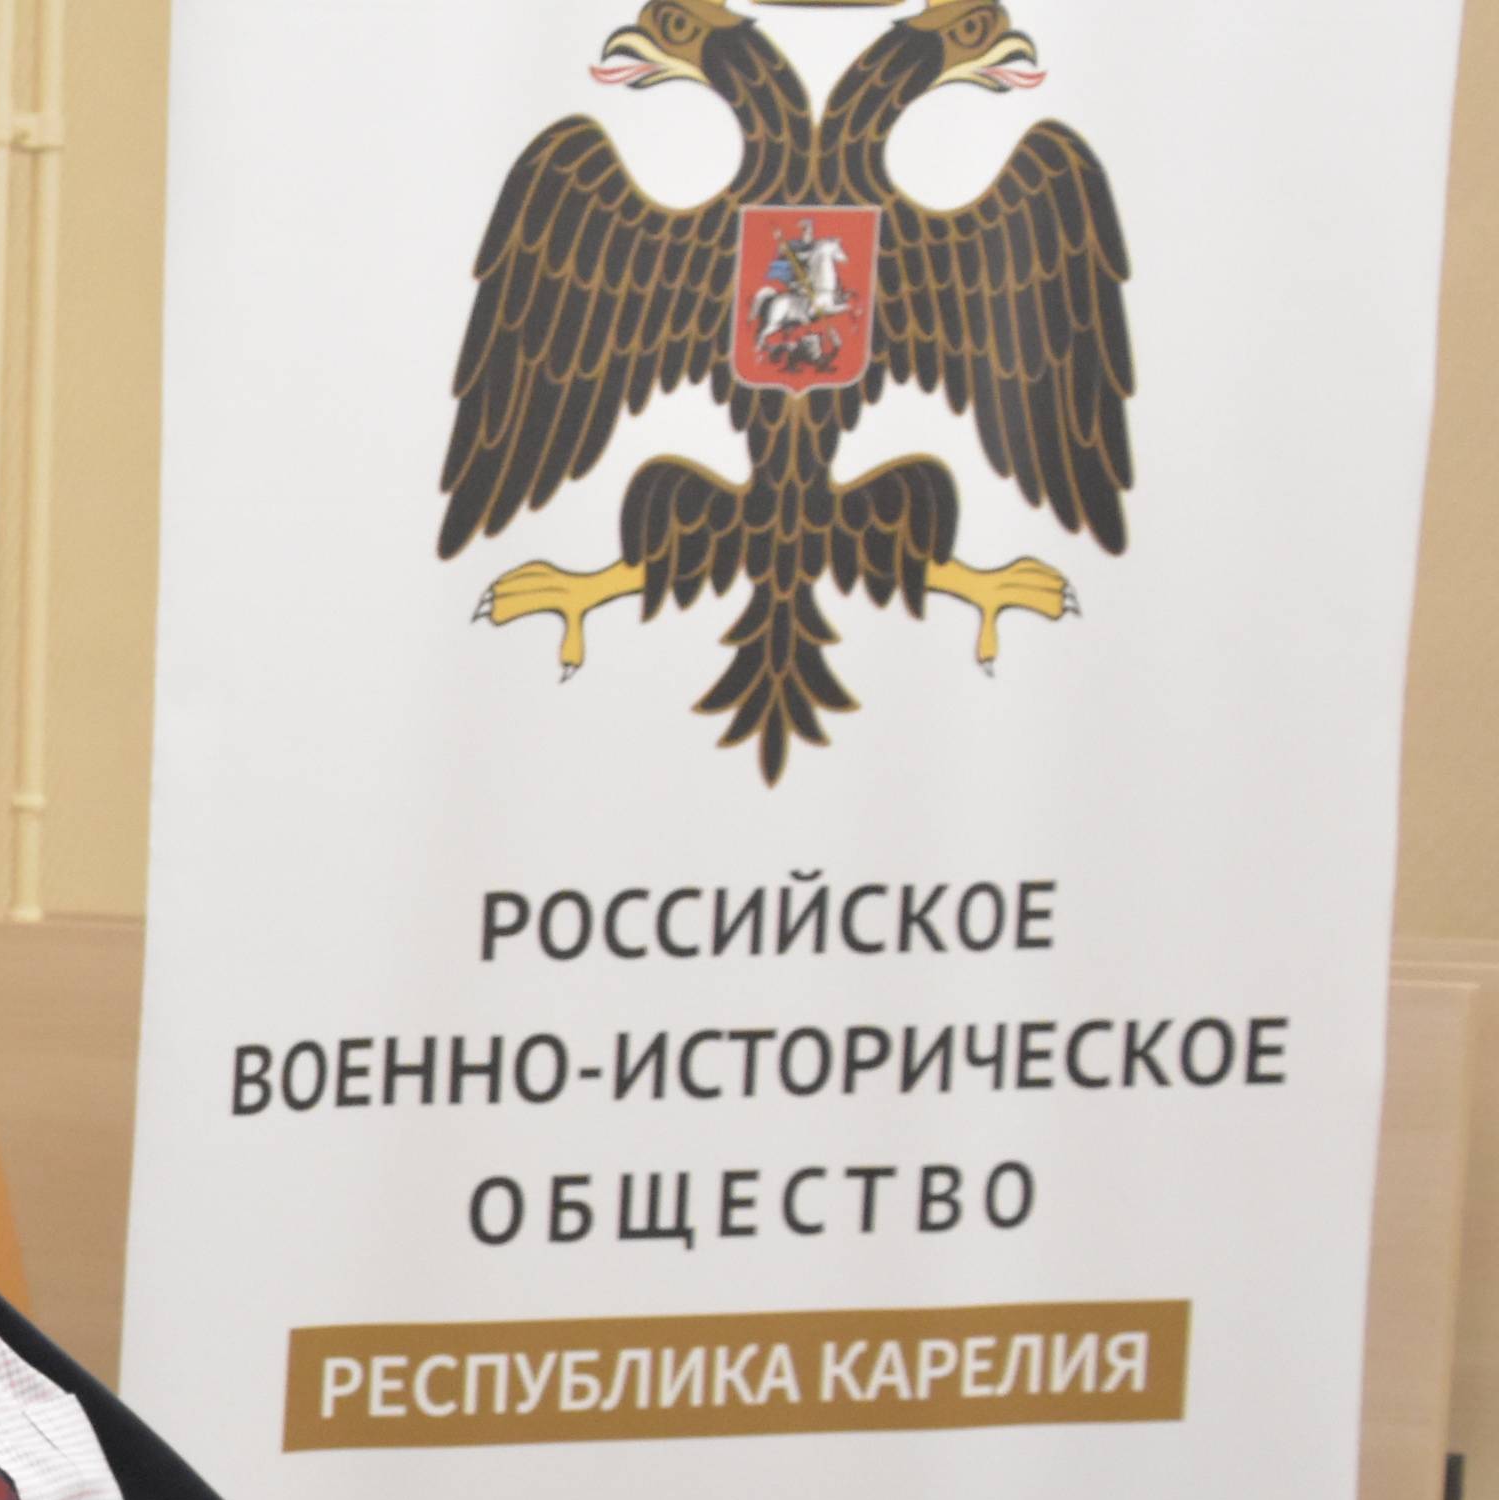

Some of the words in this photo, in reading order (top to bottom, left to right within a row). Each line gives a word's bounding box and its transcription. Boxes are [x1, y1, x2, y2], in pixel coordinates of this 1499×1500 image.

[480, 869, 1058, 962] РОССИЙСКОЕ
[231, 1017, 1289, 1116] ВОЕННО-ИСТОРИЧЕСКОЕ
[468, 1161, 1036, 1250] ОБЩЕСТВО
[321, 1342, 801, 1419] РЕСПУБЛИКА
[819, 1331, 1150, 1402] КАРЕЛИЯ
